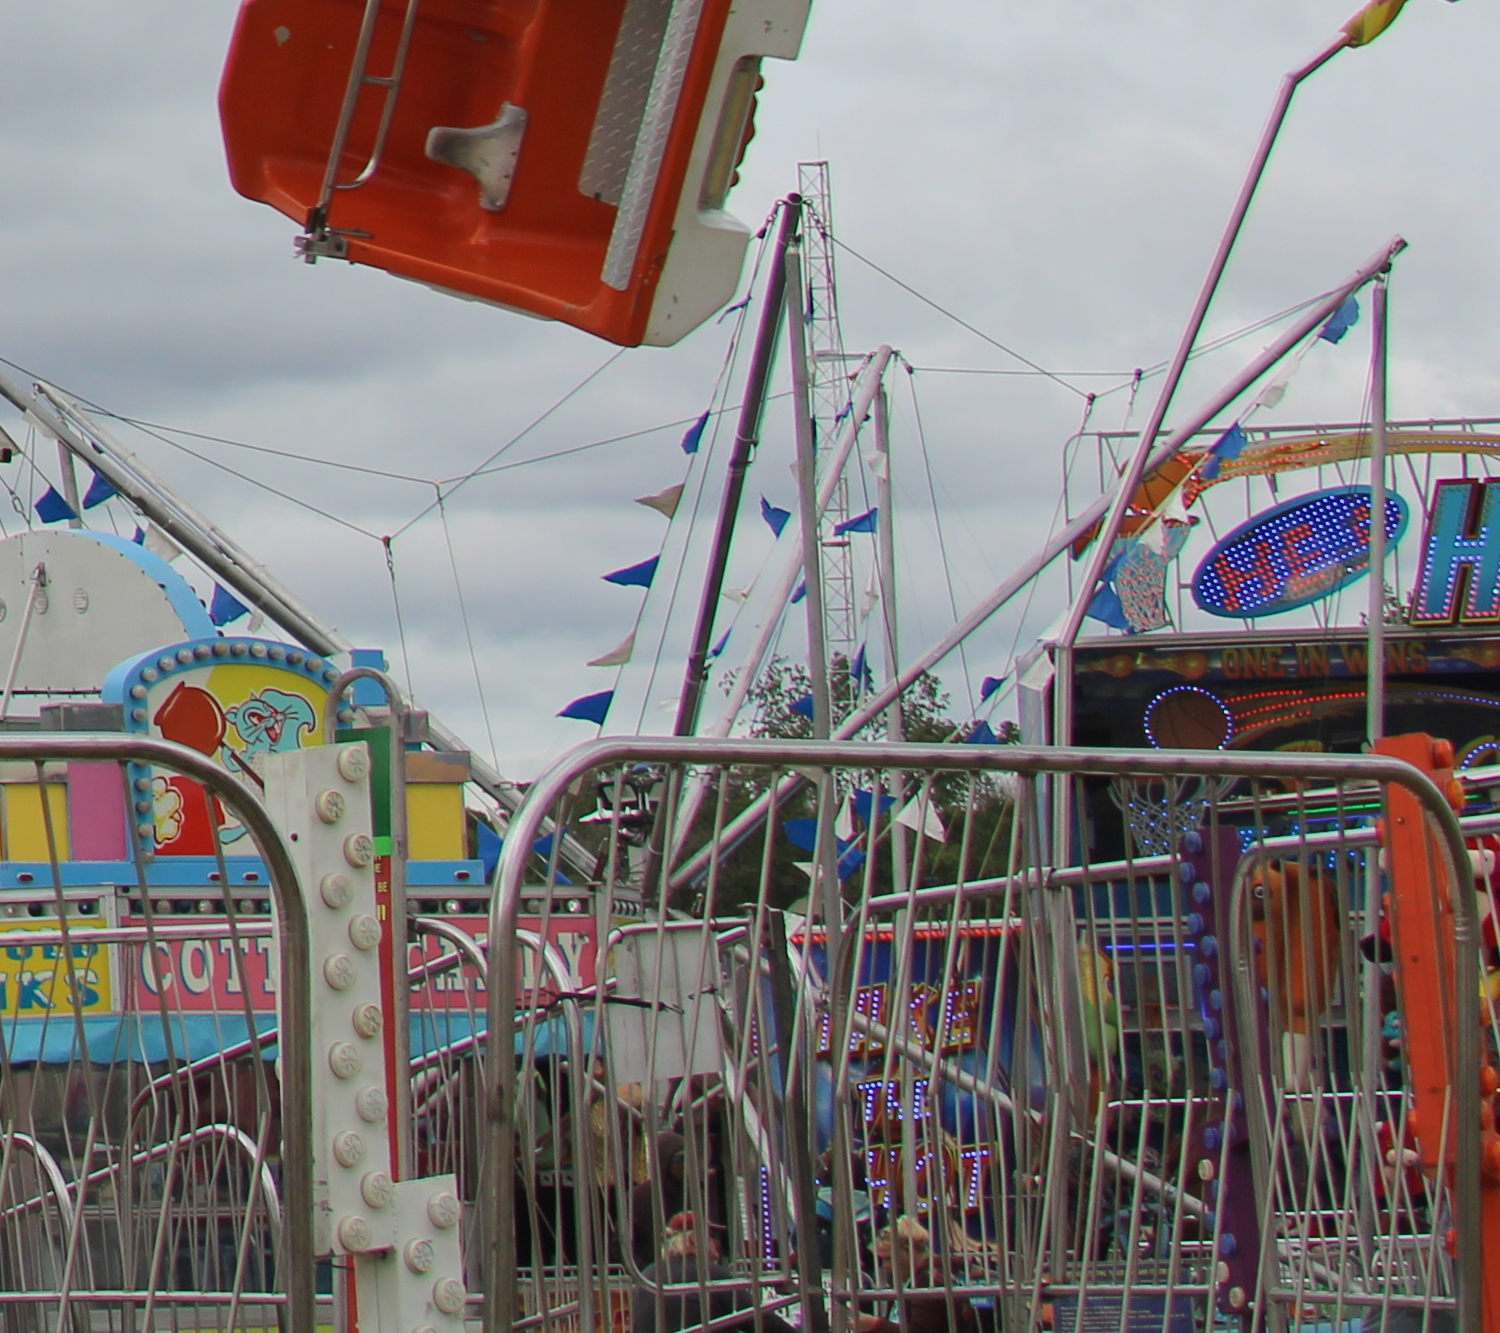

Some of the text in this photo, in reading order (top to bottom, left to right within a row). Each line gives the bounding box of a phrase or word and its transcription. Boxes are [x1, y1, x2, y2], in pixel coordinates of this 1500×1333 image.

[1221, 647, 1286, 678] ONE
[1338, 642, 1430, 677] WNS
[140, 940, 279, 995] COTT
